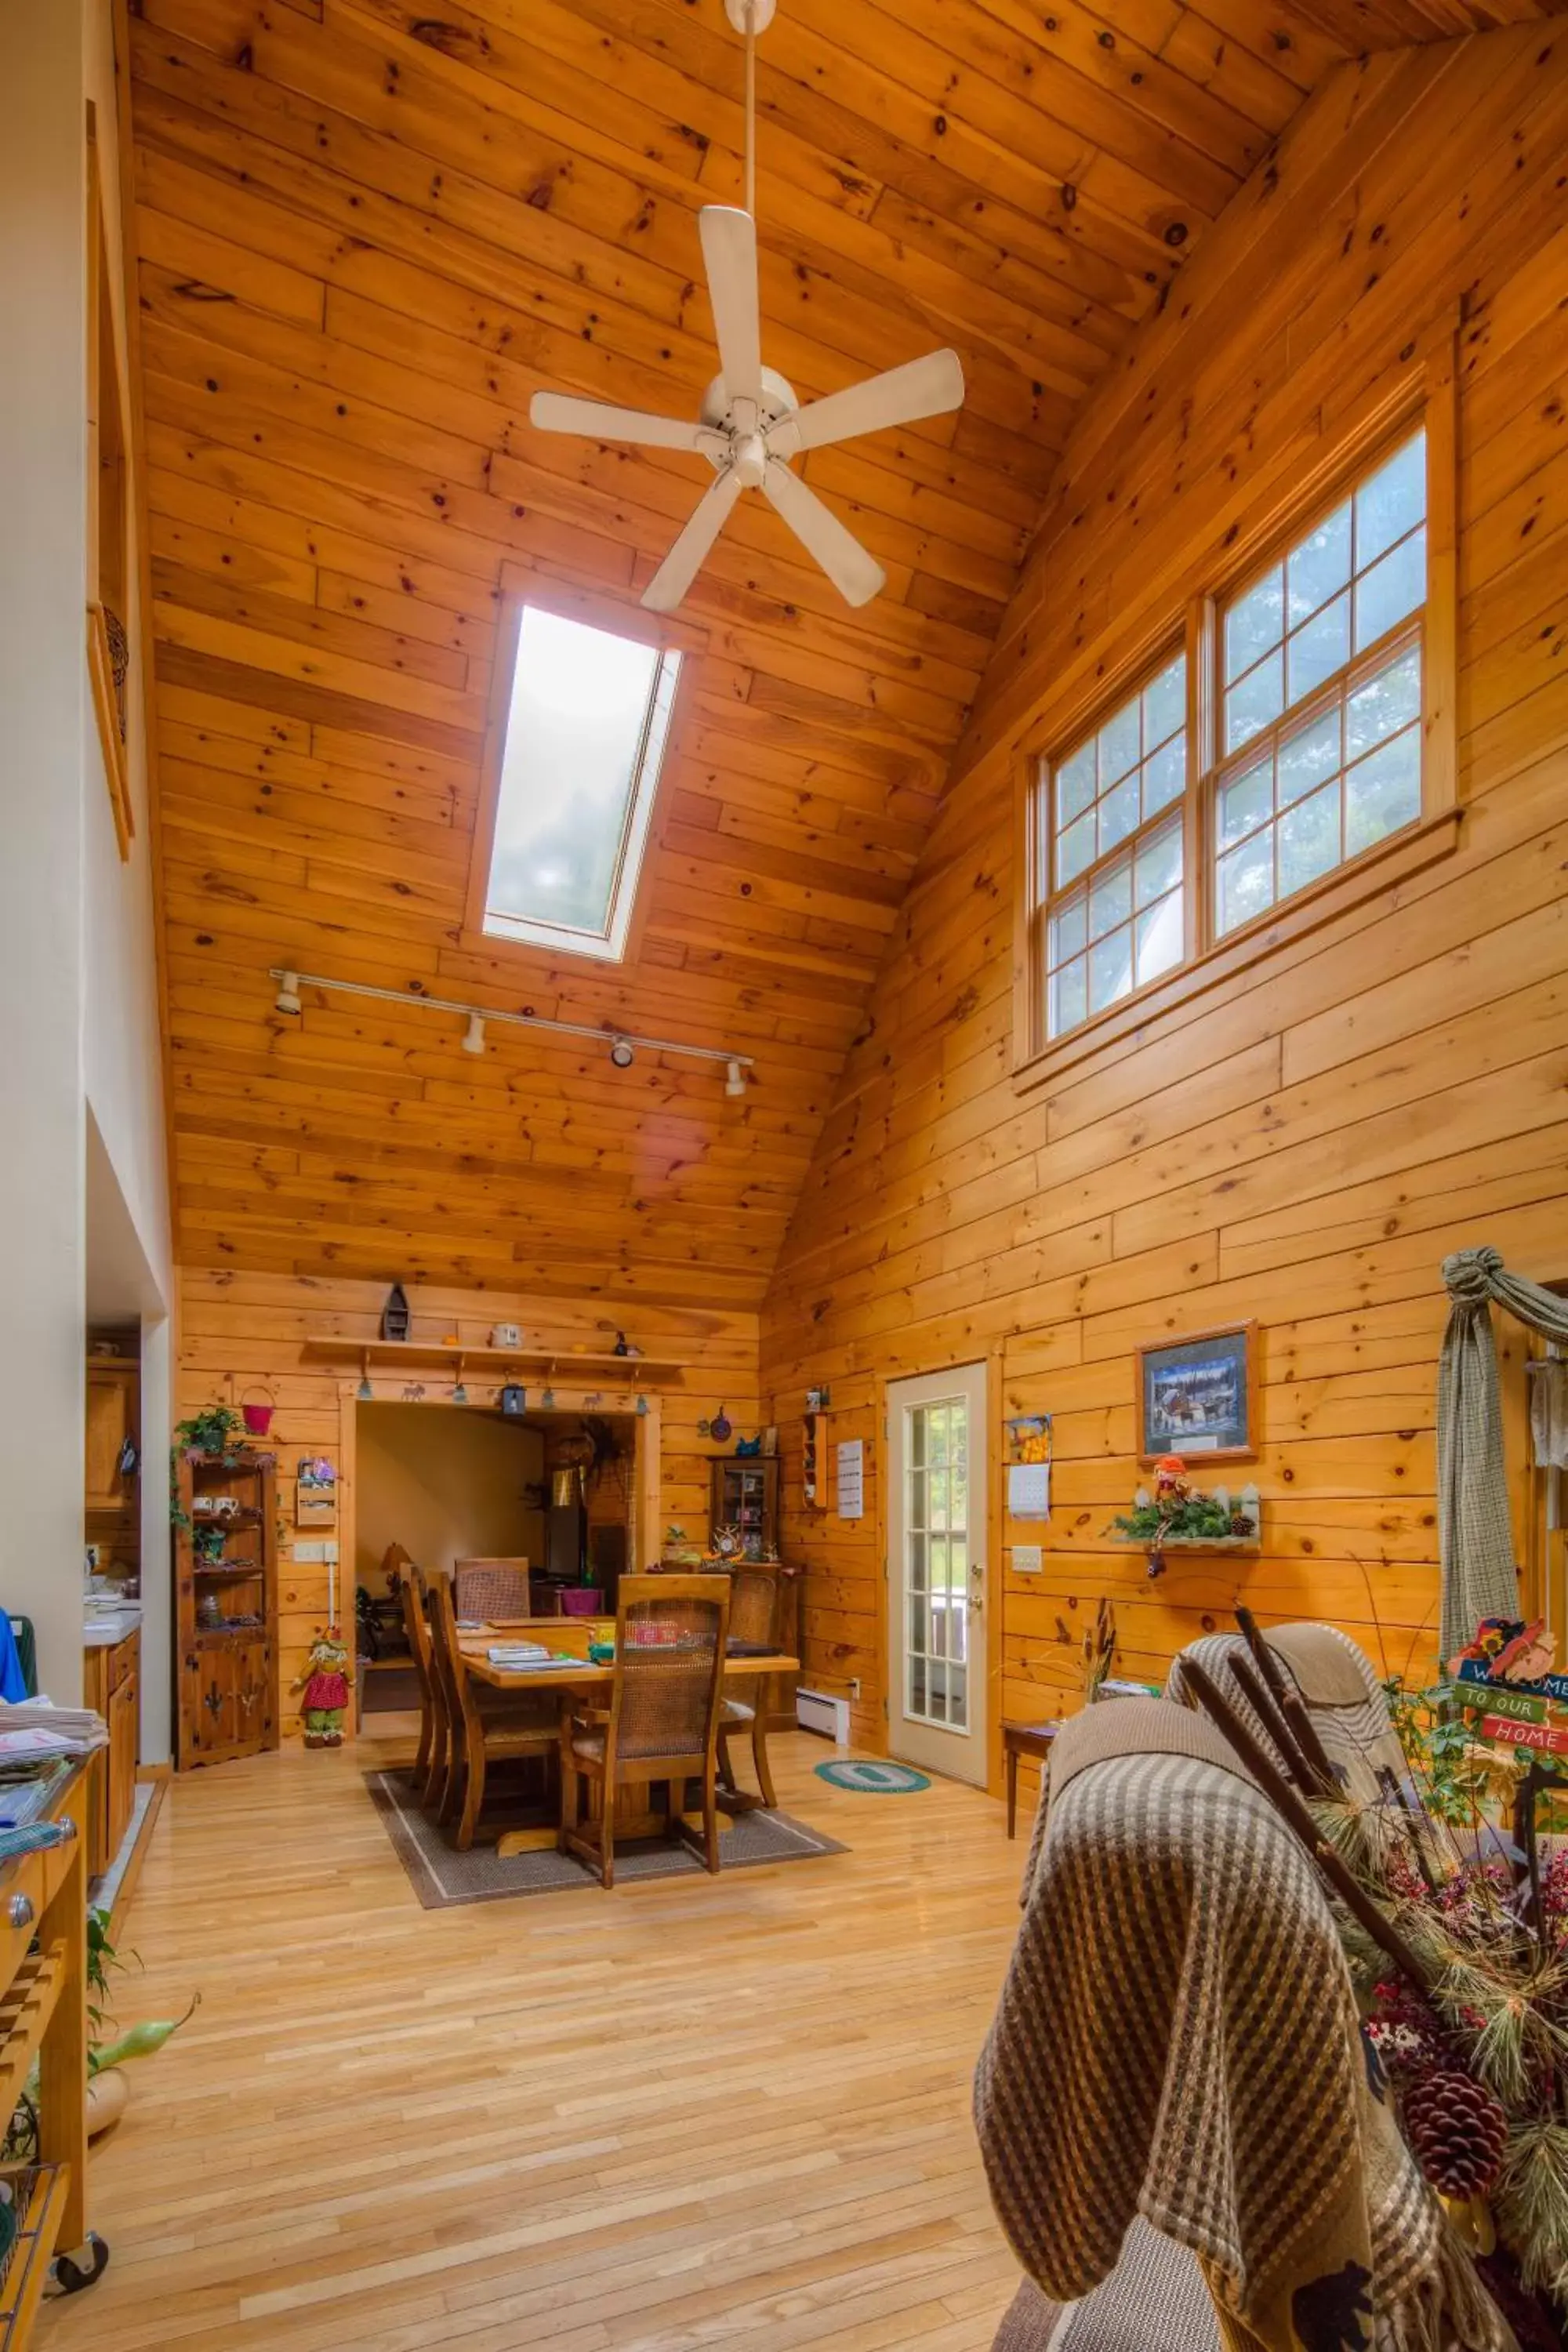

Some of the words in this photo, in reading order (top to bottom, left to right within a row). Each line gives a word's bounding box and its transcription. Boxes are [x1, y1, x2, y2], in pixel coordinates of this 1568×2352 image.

[1465, 1688, 1487, 1704] TO
[1497, 1697, 1531, 1716] OUR
[1495, 1722, 1559, 1748] HOME
